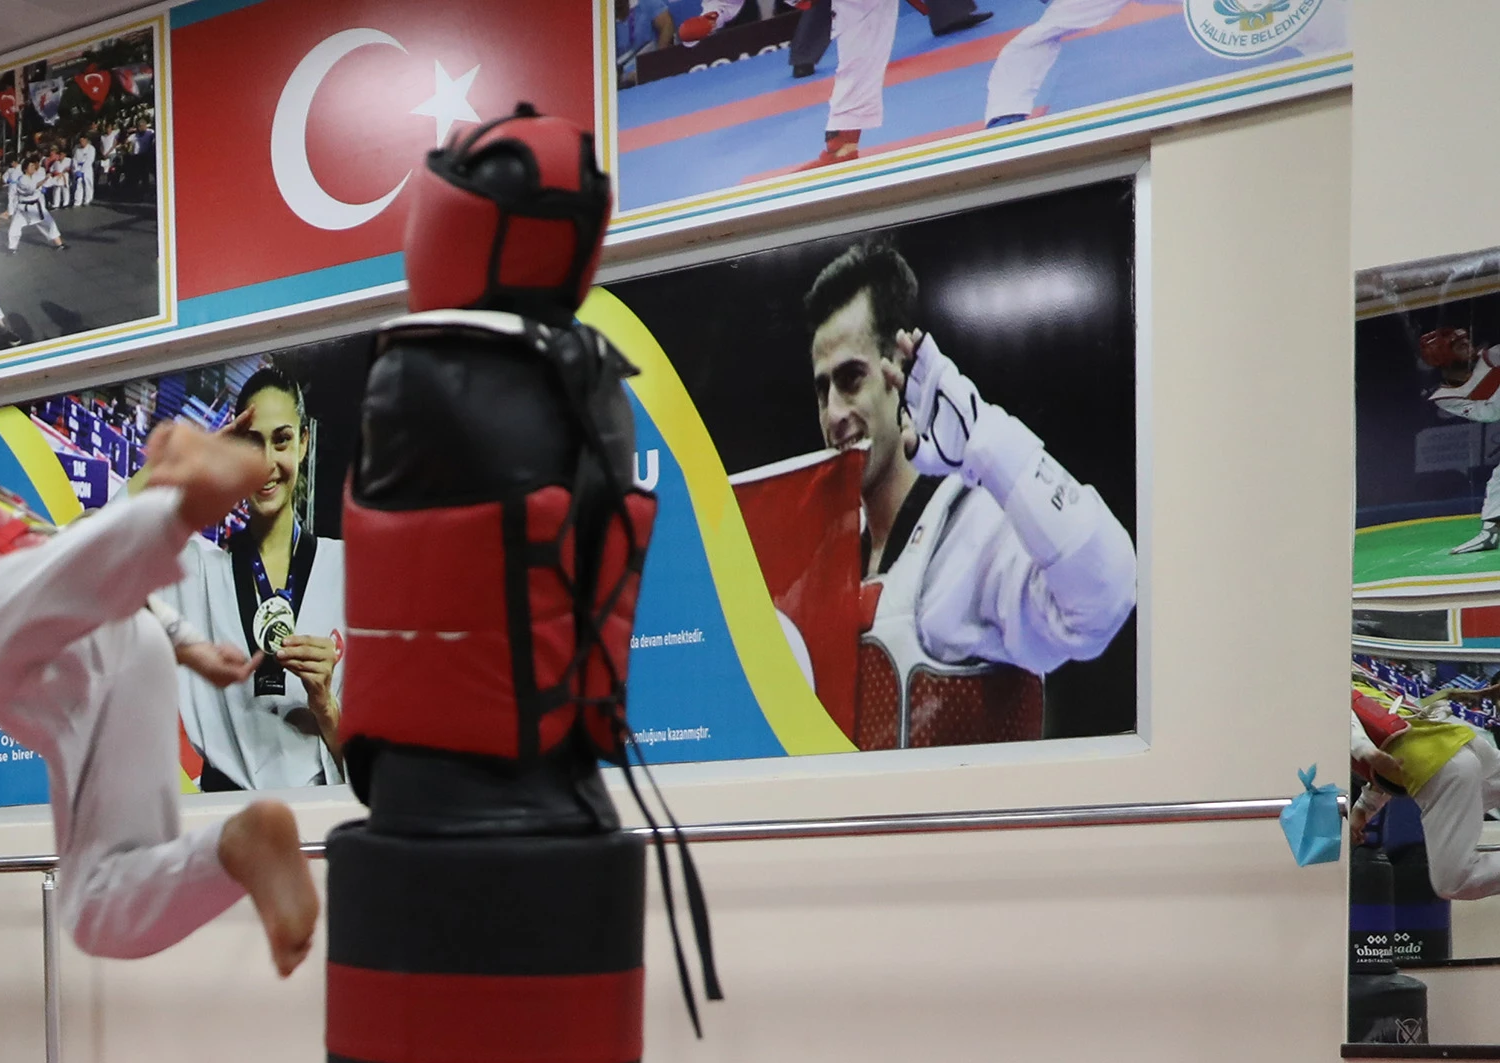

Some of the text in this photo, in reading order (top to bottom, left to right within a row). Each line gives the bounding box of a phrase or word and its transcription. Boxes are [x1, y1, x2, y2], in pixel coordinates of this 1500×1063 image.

[1250, 0, 1315, 45] BELEDİYES
[641, 634, 663, 647] devam
[664, 629, 705, 645] etmektedir.
[12, 749, 35, 761] birer
